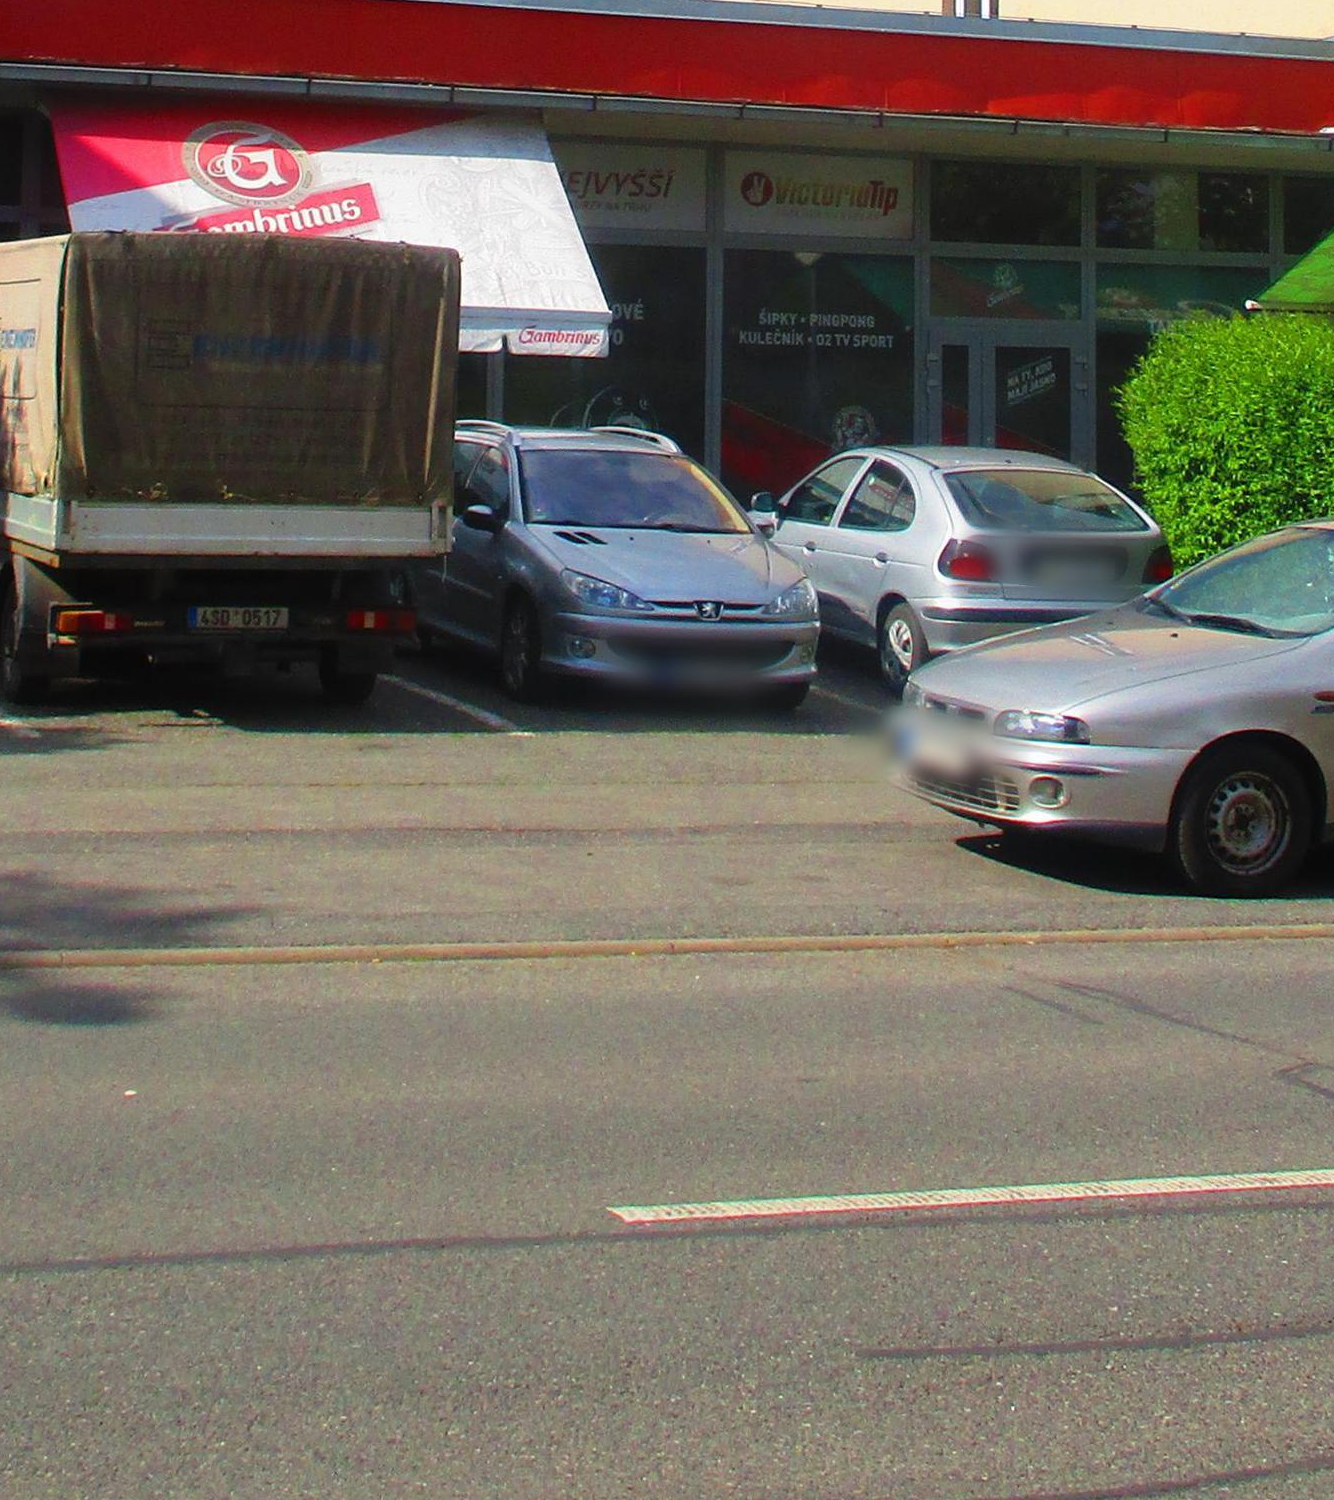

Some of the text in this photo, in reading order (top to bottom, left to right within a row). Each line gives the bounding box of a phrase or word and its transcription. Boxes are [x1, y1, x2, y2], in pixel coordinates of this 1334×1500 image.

[567, 167, 677, 199] EJVYŠŠÍ
[758, 307, 875, 328] ŠIPKY PINGPONG
[518, 324, 601, 345] Gambrinus
[738, 328, 804, 346] KULEČNÍK
[834, 333, 851, 347] TV
[852, 334, 895, 349] SPORT
